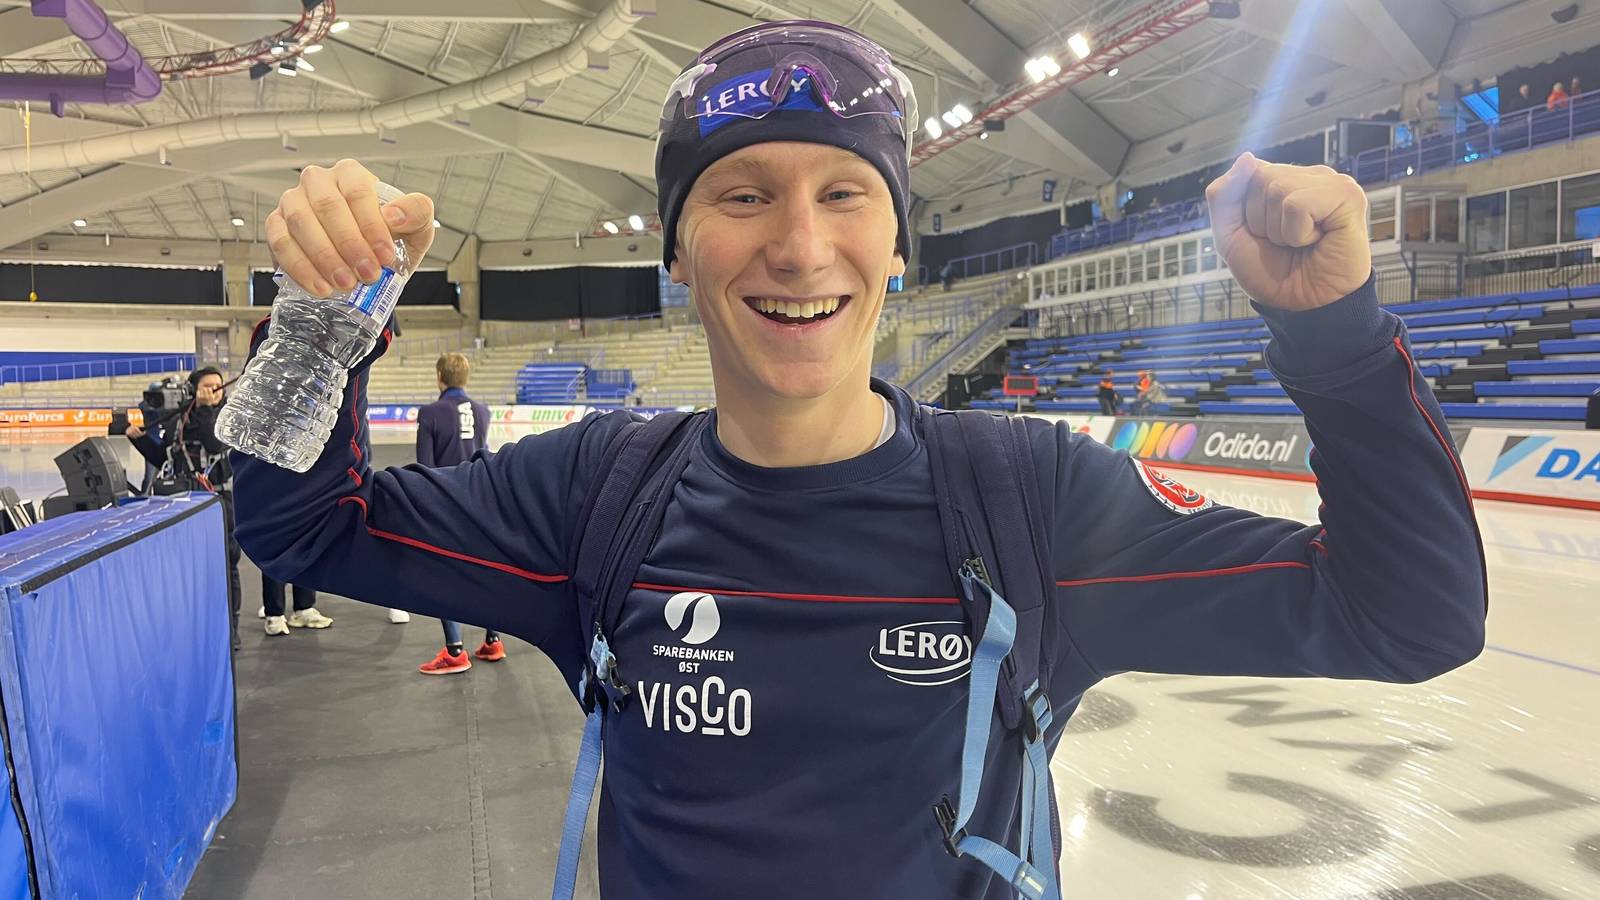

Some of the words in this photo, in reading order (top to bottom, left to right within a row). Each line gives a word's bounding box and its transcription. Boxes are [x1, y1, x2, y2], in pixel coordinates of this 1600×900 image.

[457, 402, 475, 439] USA
[1204, 431, 1298, 462] Odido.nl
[652, 644, 734, 662] SPAREBANKEN
[678, 661, 700, 673] ØST
